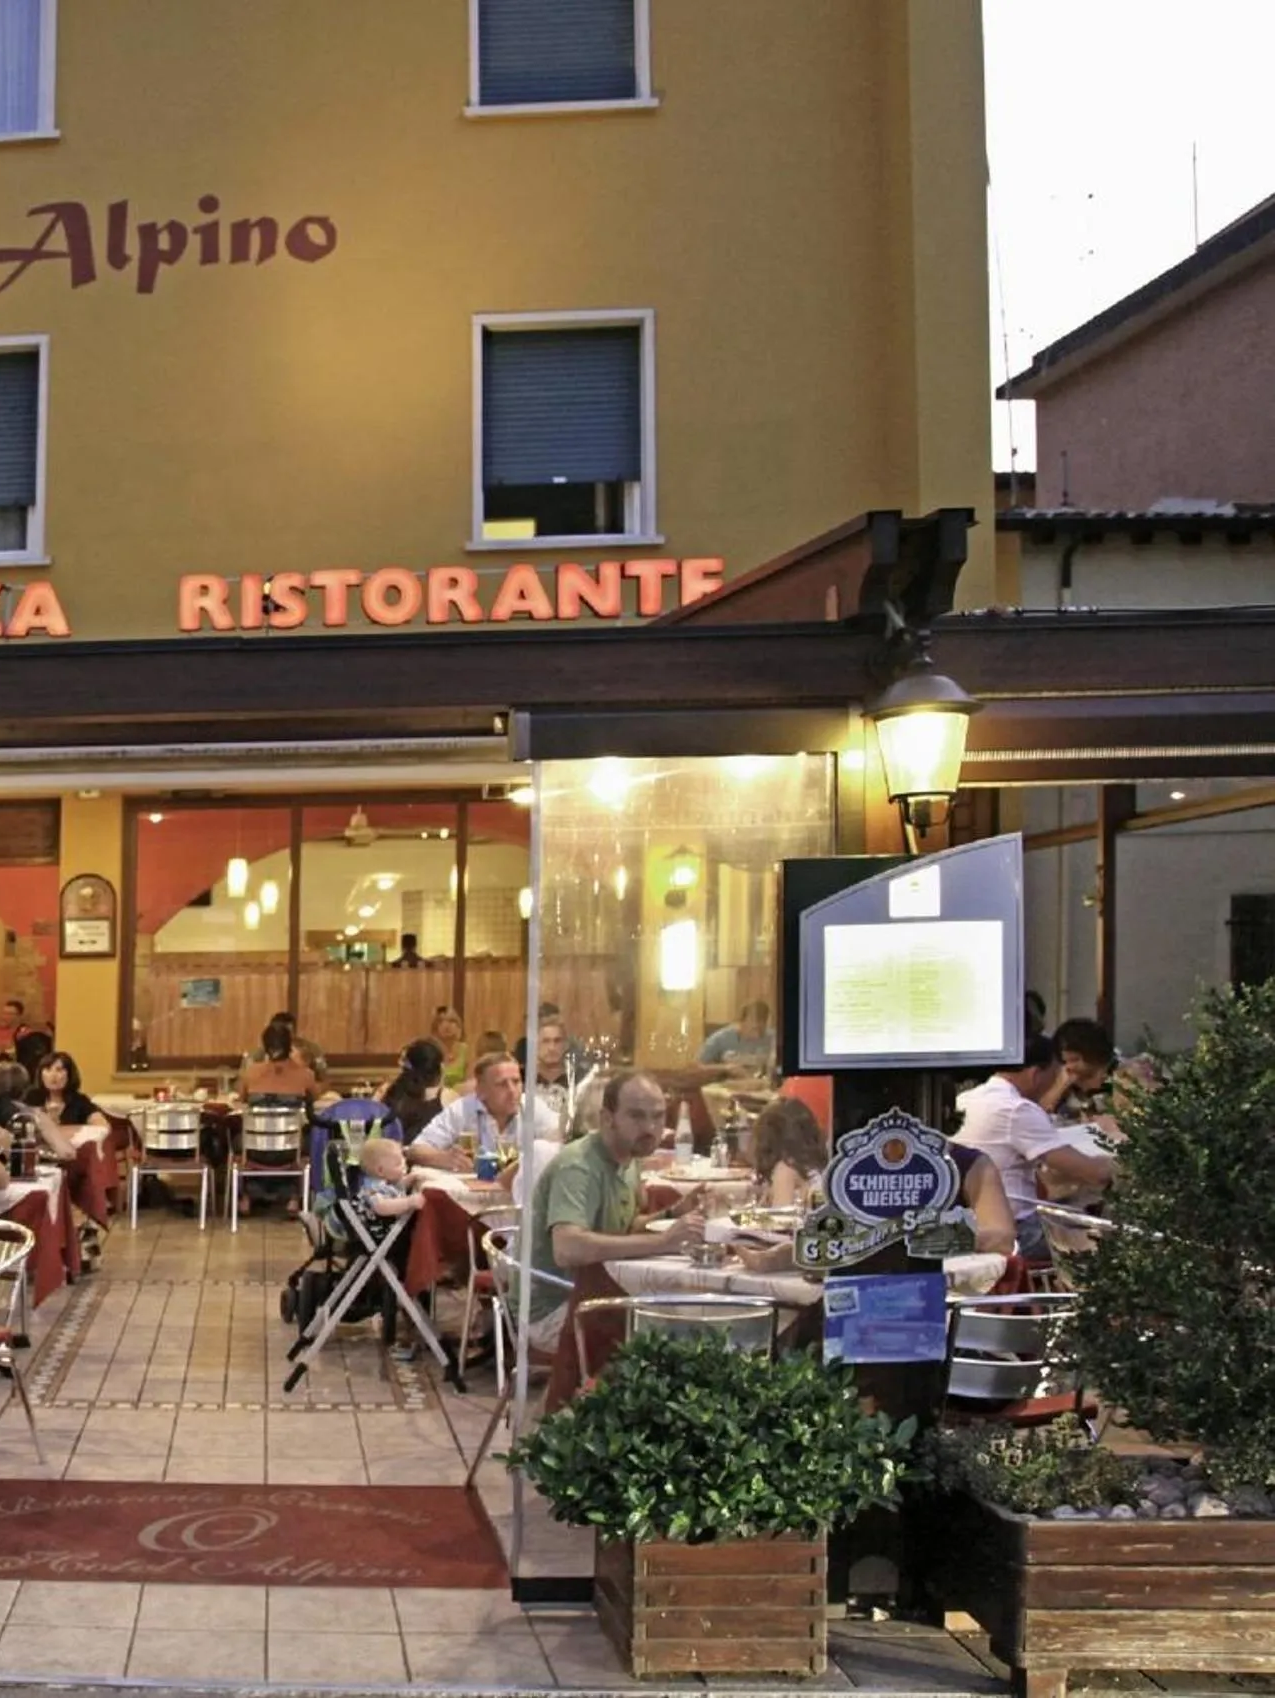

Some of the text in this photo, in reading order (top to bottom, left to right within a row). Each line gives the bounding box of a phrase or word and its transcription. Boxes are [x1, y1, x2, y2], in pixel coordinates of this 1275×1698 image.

[178, 557, 726, 634] RISTORANTE
[849, 1173, 934, 1191] SCHNEIDER
[862, 1190, 920, 1206] WEISSE
